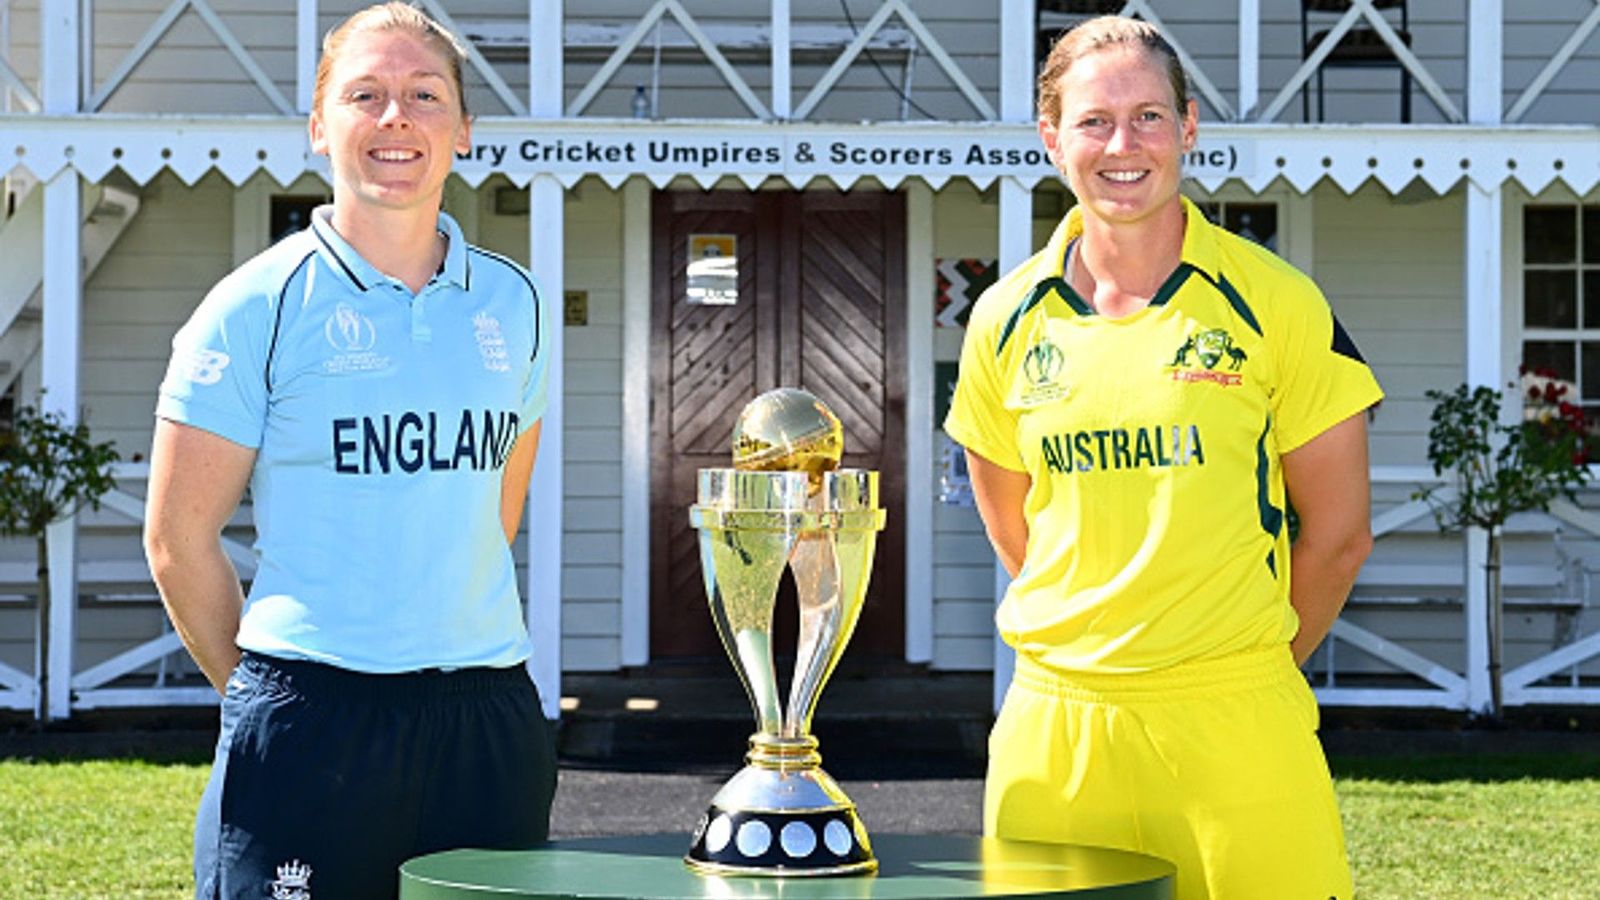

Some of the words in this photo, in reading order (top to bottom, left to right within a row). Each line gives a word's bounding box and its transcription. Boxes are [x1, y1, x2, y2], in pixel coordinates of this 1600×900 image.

[520, 139, 635, 162] Cricket
[649, 141, 781, 168] Umpires
[794, 141, 816, 164] &
[830, 141, 953, 165] Scorers
[333, 408, 520, 474] ENGLAND
[1041, 424, 1205, 474] AUSTRALIA
